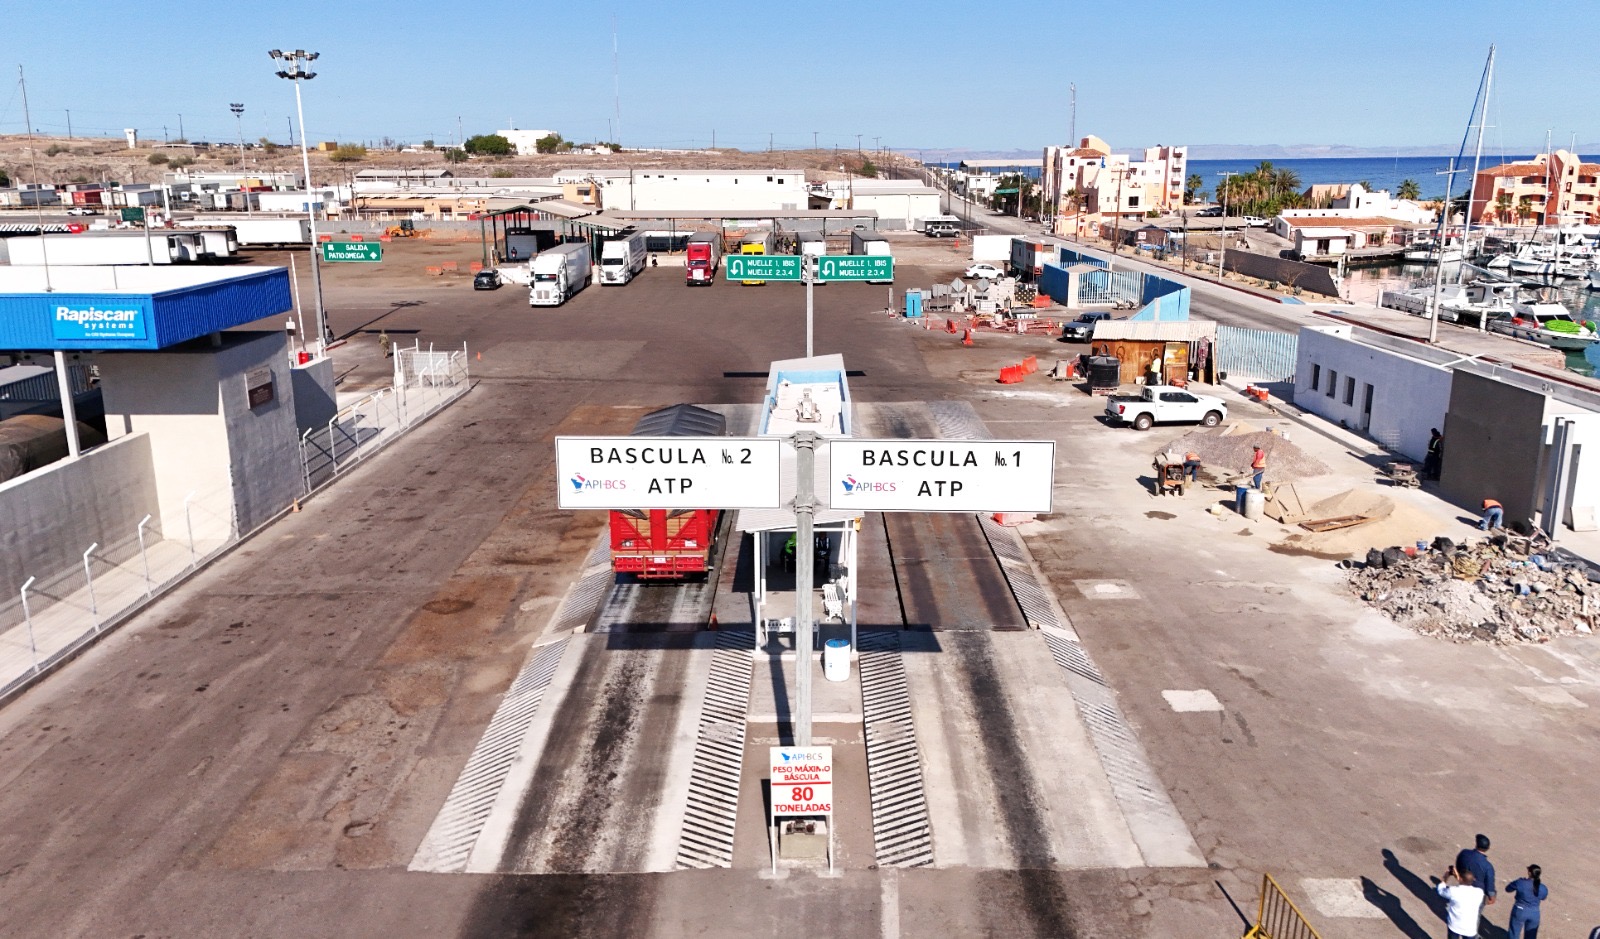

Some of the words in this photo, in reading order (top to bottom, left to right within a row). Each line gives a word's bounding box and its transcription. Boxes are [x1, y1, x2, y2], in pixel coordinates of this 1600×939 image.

[56, 306, 135, 325] Rapiscan
[84, 322, 134, 330] systems
[590, 447, 707, 464] BASCULA
[721, 448, 734, 464] No.
[740, 448, 752, 464] 2
[862, 449, 978, 467] BASCULA
[994, 450, 1008, 467] No.
[1012, 450, 1021, 467] 1
[647, 477, 693, 494] ATP
[917, 480, 963, 497] ATP
[784, 772, 820, 781] BÁSCULA
[791, 786, 814, 802] 80
[773, 803, 831, 813] TONELADAS
